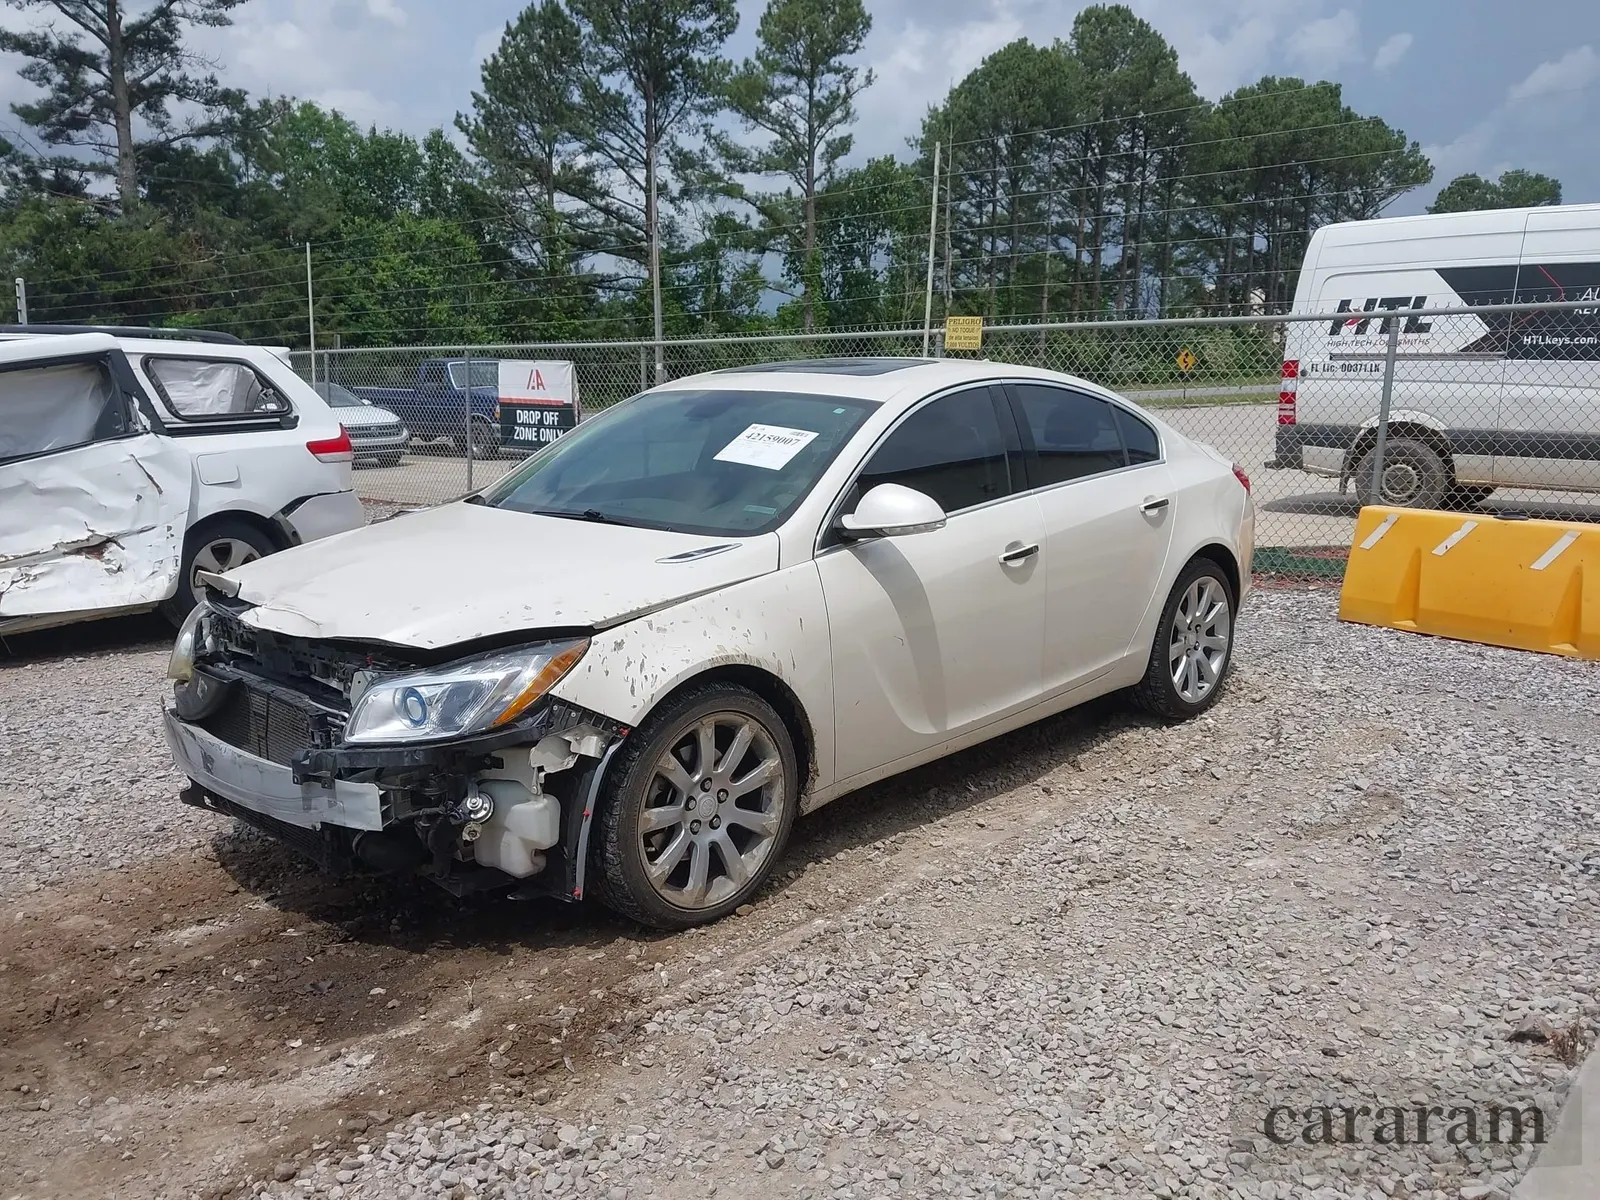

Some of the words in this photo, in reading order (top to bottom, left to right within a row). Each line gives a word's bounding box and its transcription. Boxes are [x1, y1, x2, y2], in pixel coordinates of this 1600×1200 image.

[1329, 296, 1432, 335] HTL
[1523, 335, 1598, 346] HTLkeys.com
[516, 409, 541, 425] DROP
[543, 411, 559, 426] OFF
[514, 427, 538, 440] ZONE
[540, 428, 564, 443] ONLY
[745, 432, 801, 446] 42159007
